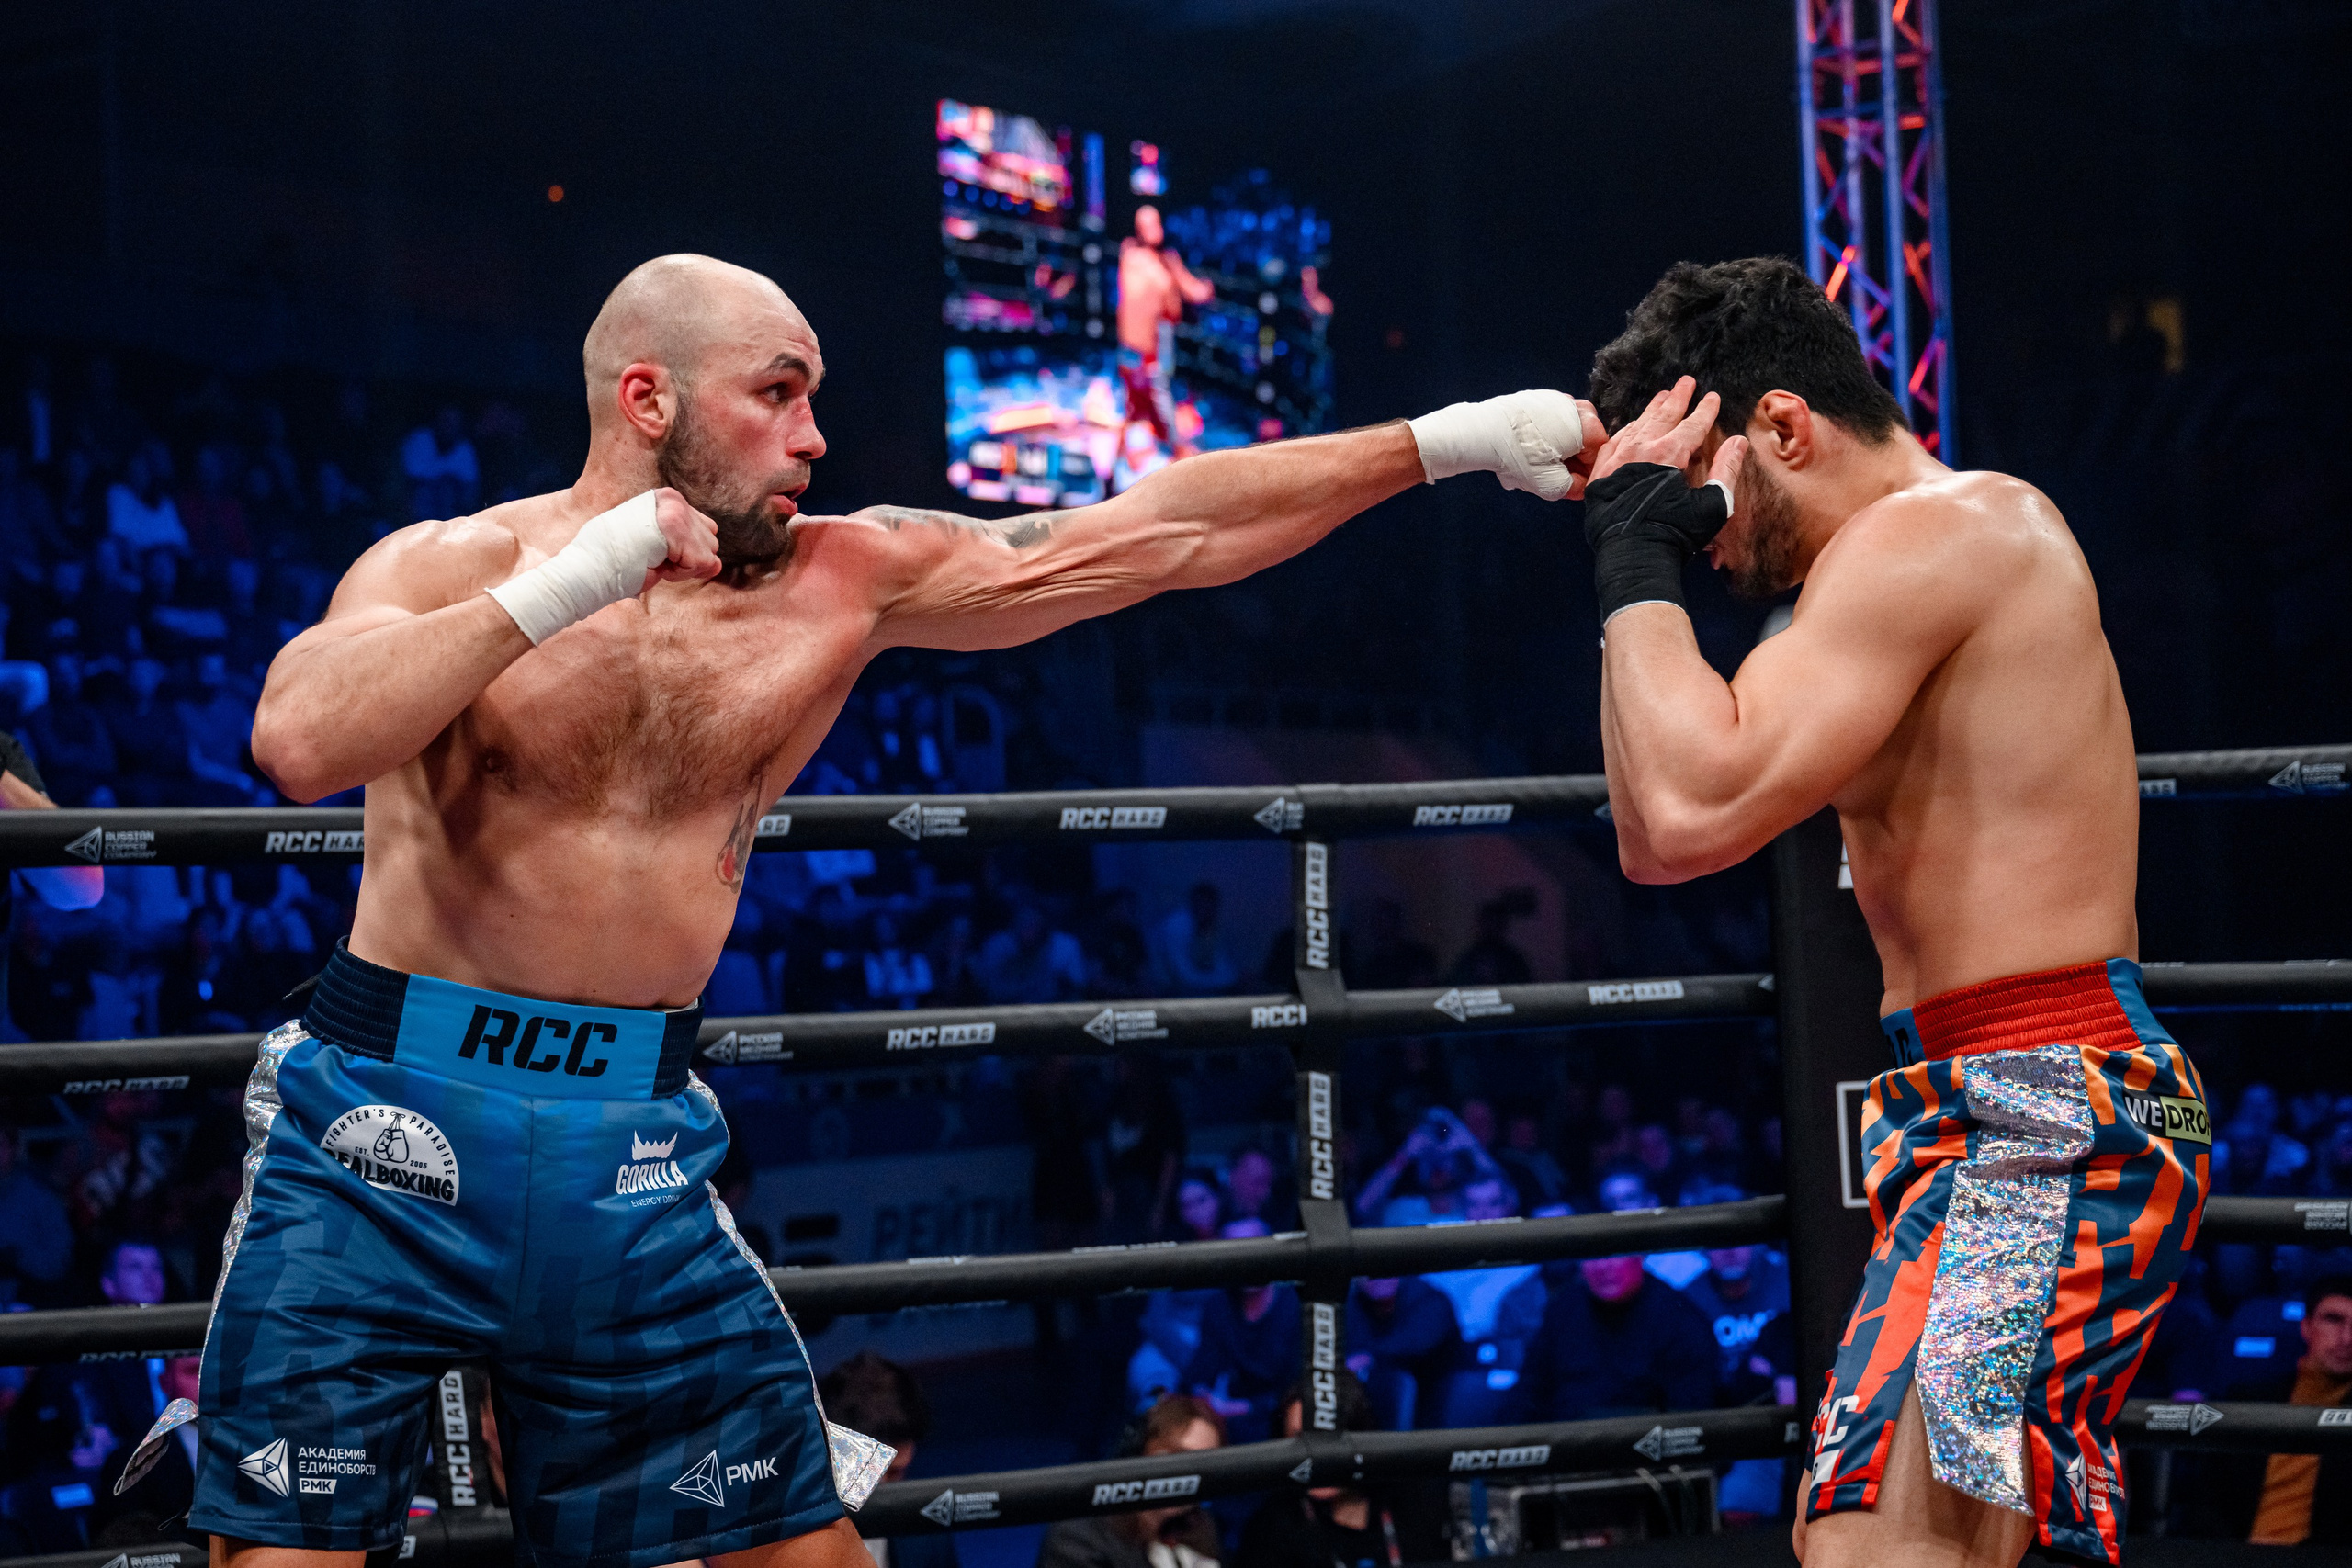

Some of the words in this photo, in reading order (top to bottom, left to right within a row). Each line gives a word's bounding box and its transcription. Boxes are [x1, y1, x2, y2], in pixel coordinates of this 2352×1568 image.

[1059, 807, 1112, 829] RCC
[1414, 805, 1462, 827] RCC
[265, 830, 323, 854] RCC
[1306, 908, 1329, 969] RCC
[458, 1004, 617, 1077] RCC
[886, 1026, 938, 1051] RCC
[326, 1109, 384, 1147] FIGHTER'S
[409, 1116, 456, 1176] PARADISE
[355, 1146, 369, 1156] EST.
[410, 1160, 428, 1169] 2005
[1311, 1139, 1334, 1200] RCC
[616, 1160, 689, 1195] GORILLA
[630, 1196, 661, 1207] ENERGY
[442, 1373, 467, 1439] HARD
[1313, 1370, 1337, 1430] RCC
[298, 1447, 366, 1461] АКАДЕМИЯ
[1449, 1450, 1498, 1471] RCC
[299, 1461, 376, 1475] ЕДИНОБОРСТВ
[447, 1443, 476, 1506] RCC
[726, 1456, 779, 1486] РМК
[300, 1479, 334, 1493] РМК
[1092, 1482, 1144, 1506] RCC
